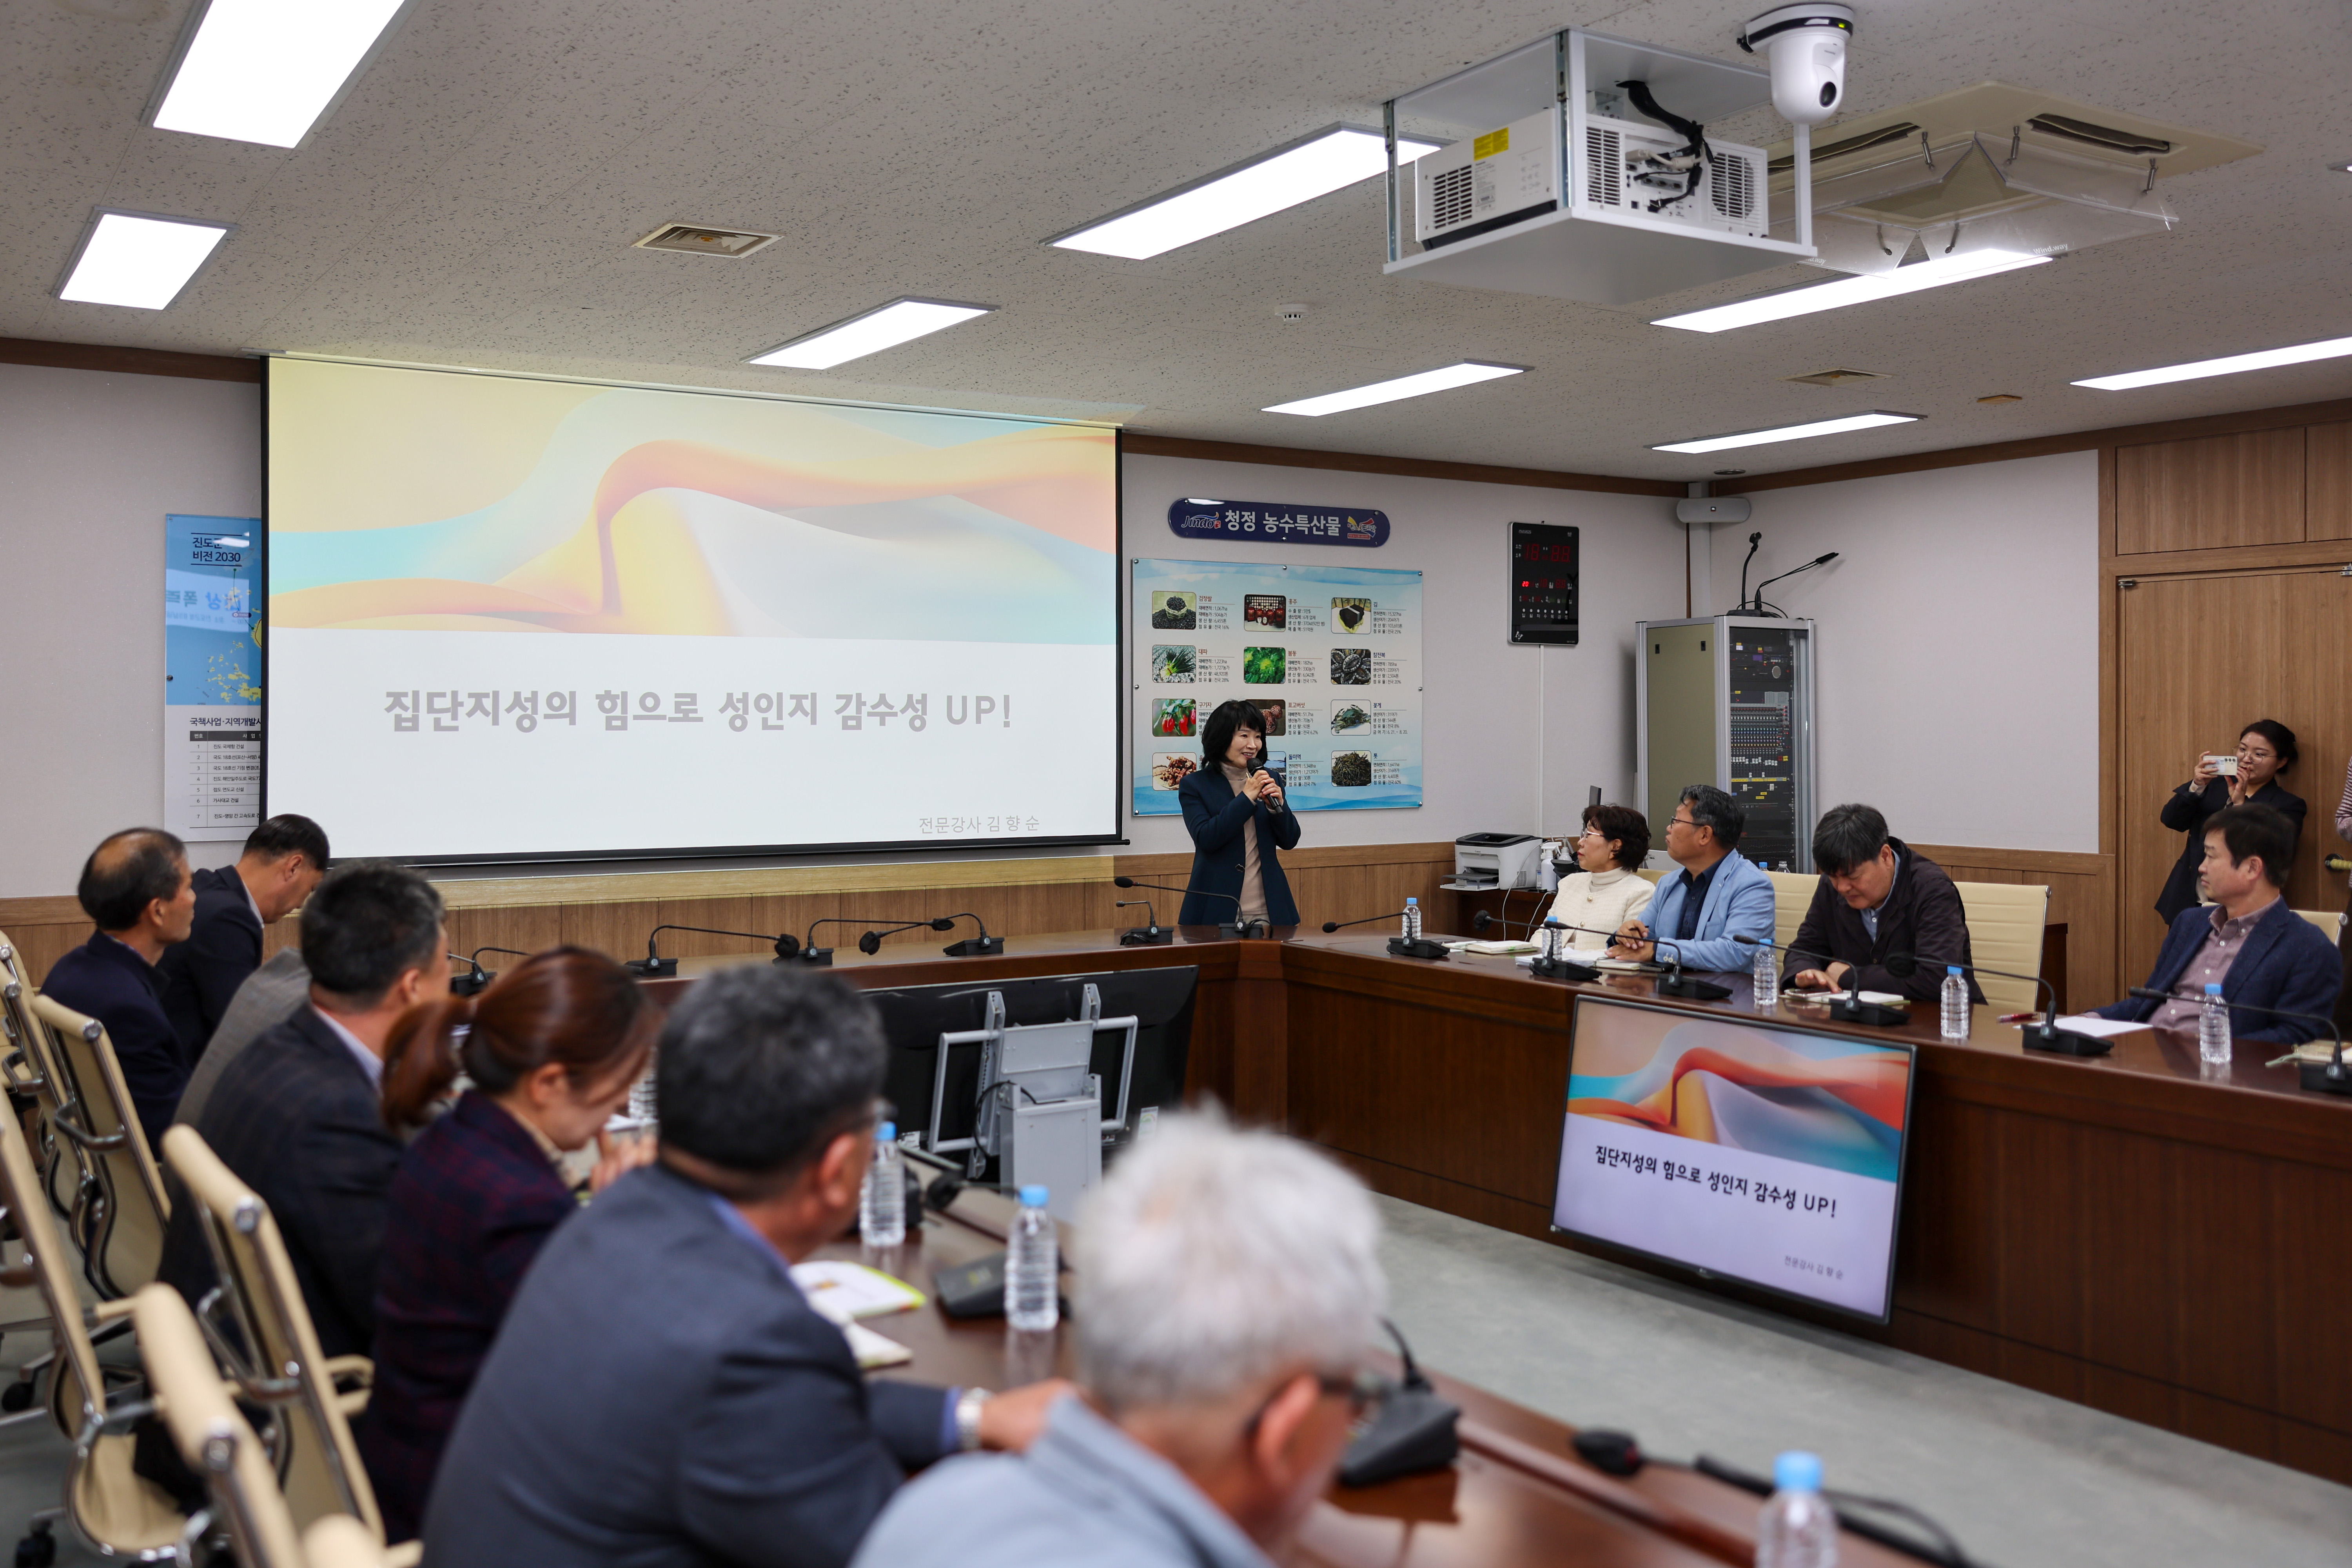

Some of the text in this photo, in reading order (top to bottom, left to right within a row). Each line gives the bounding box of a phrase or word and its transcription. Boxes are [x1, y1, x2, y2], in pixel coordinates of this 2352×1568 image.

[2033, 244, 2068, 254] Wind.way
[1225, 510, 1255, 532] 청정
[1263, 513, 1341, 536] 농수특산물
[193, 551, 241, 562] 비전 2030
[384, 690, 1011, 733] 집단지성의 힘으로 성인지 감수성 UP!
[919, 816, 982, 834] 전문강사
[1595, 1145, 1837, 1218] 집단지성의 힘으로 성인지 감수성 UP!
[1784, 1255, 1815, 1271] 전문강사
